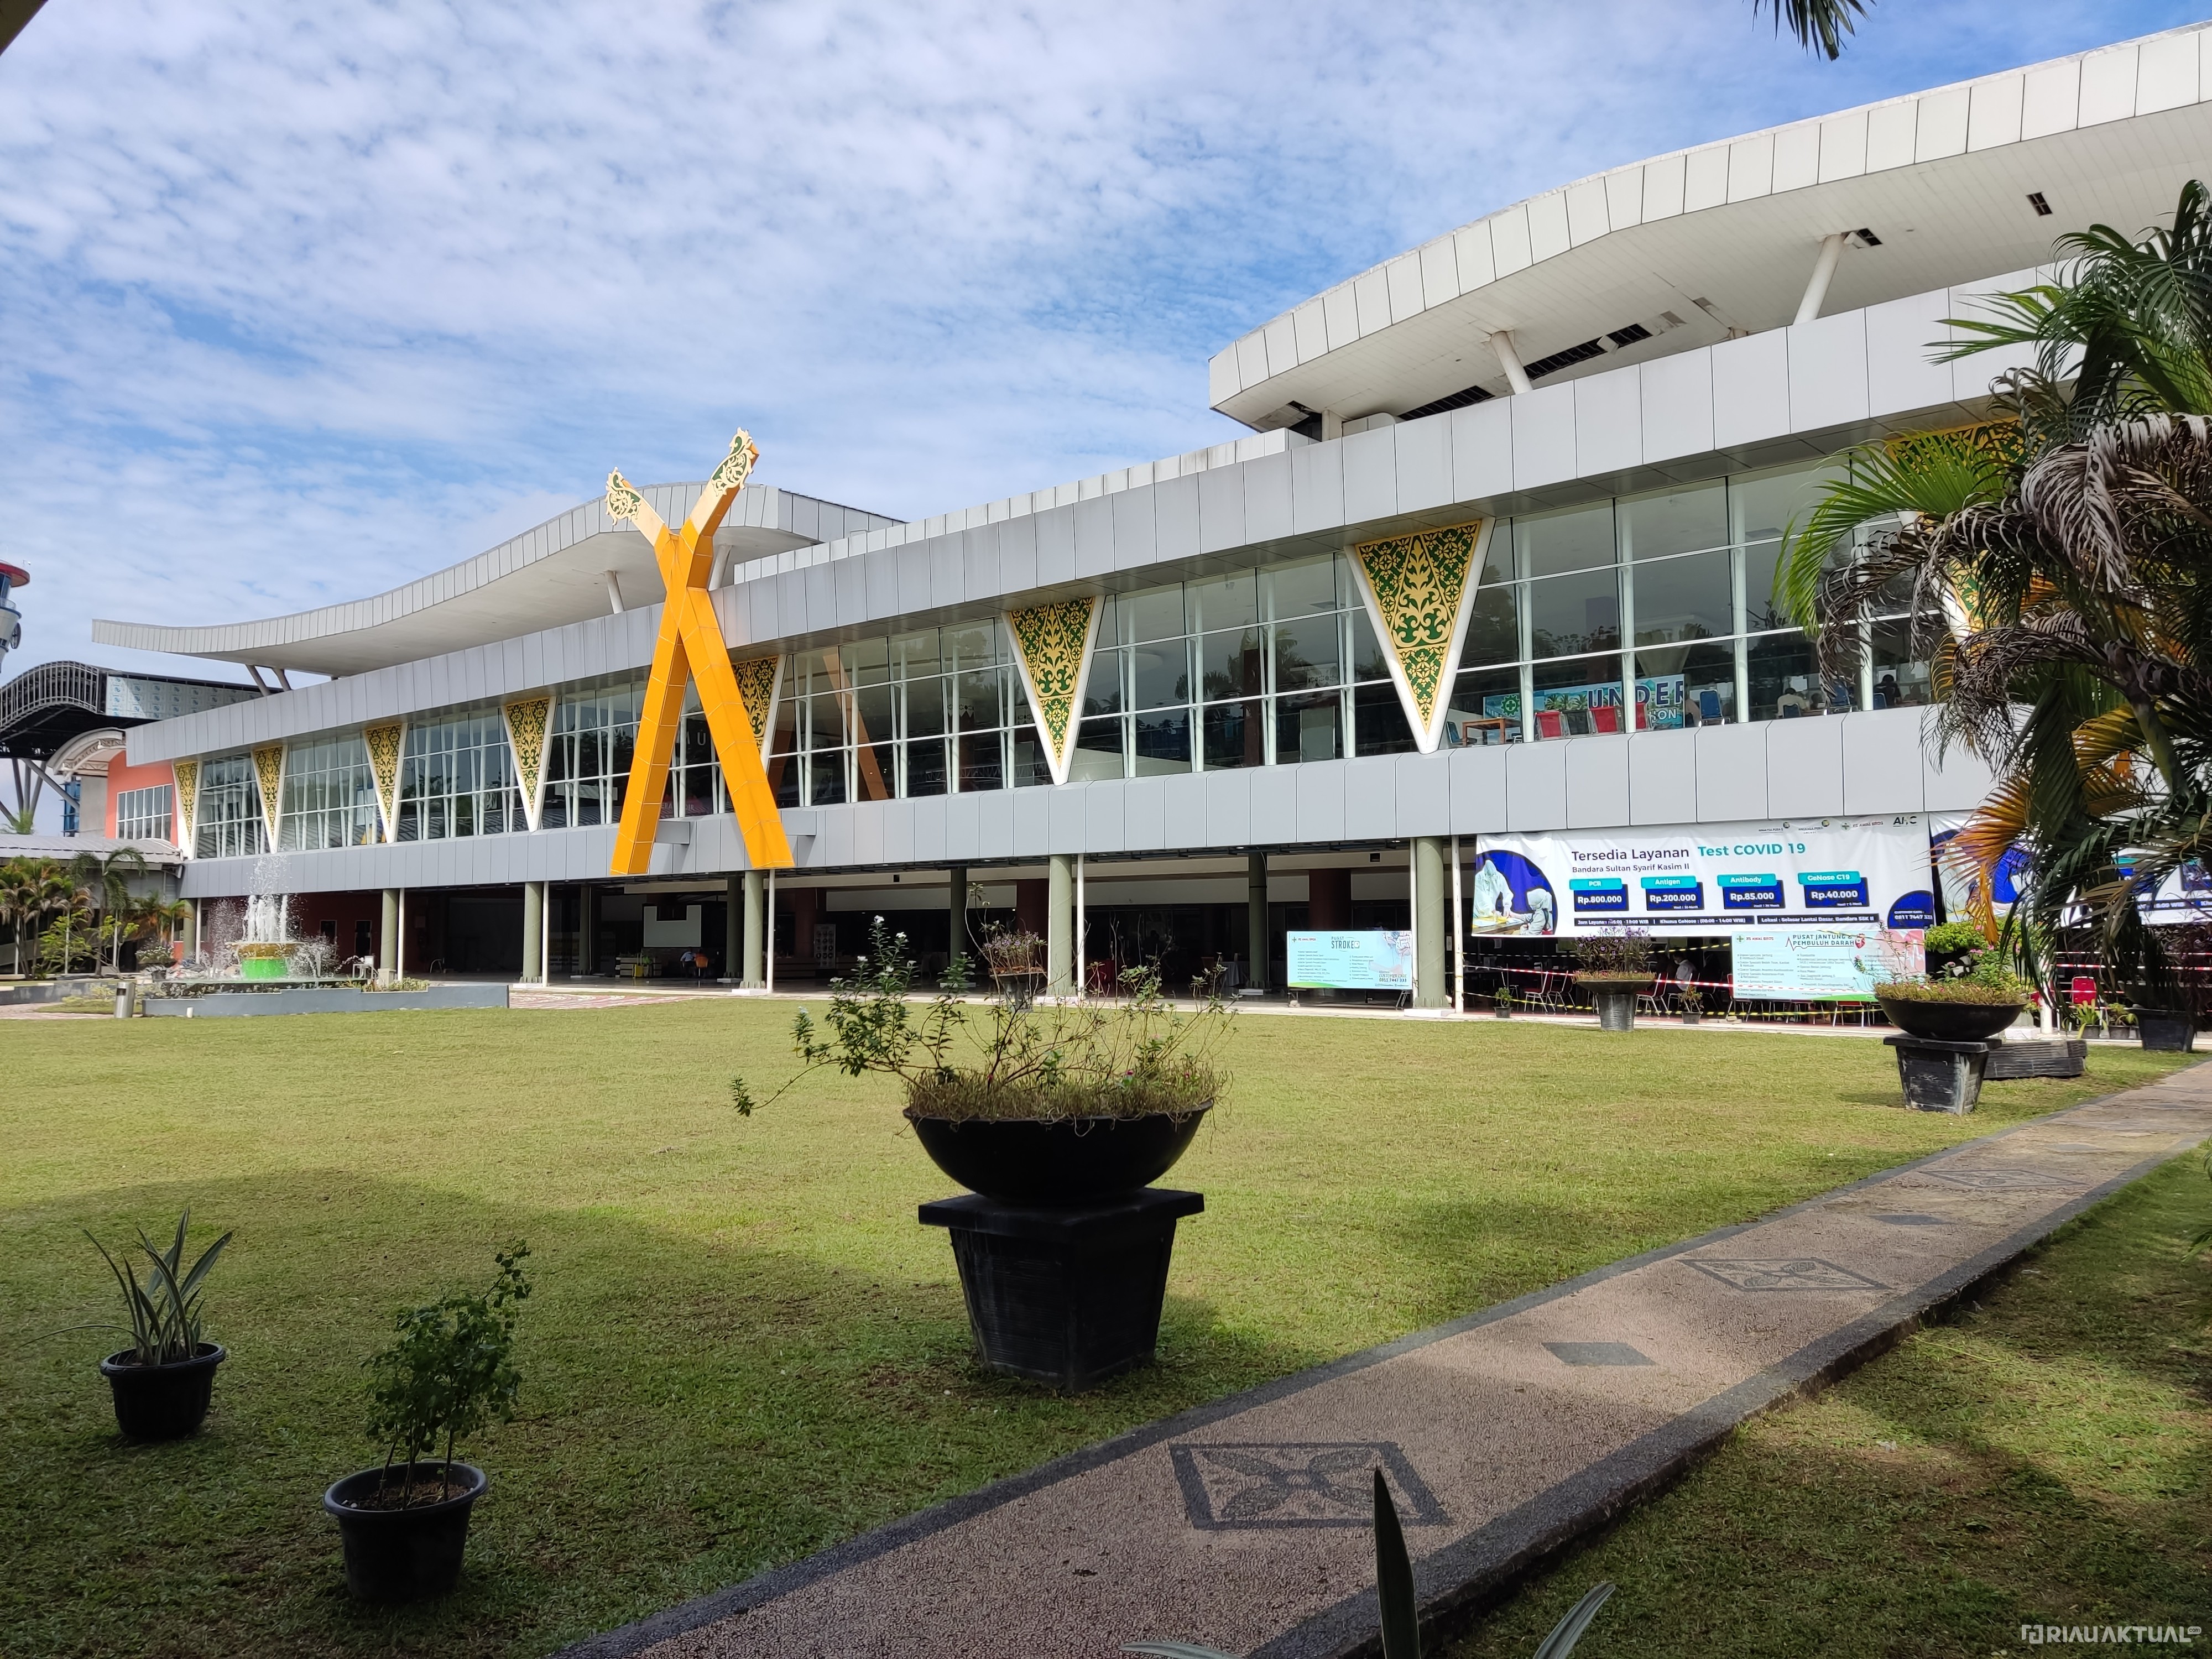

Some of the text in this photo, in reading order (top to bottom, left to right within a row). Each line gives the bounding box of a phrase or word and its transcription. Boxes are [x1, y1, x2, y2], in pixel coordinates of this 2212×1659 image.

[1698, 843, 1806, 856] Test COVID 19
[1572, 849, 1689, 861] Tersedia Layanan
[1633, 864, 1655, 873] Syarif
[1578, 895, 1622, 904] Rp.800.000
[1650, 894, 1696, 904] Rp.200.000
[1730, 892, 1775, 901] Rp.85.000
[1811, 890, 1858, 900] Rp.40.000
[1332, 941, 1354, 949] STROKE
